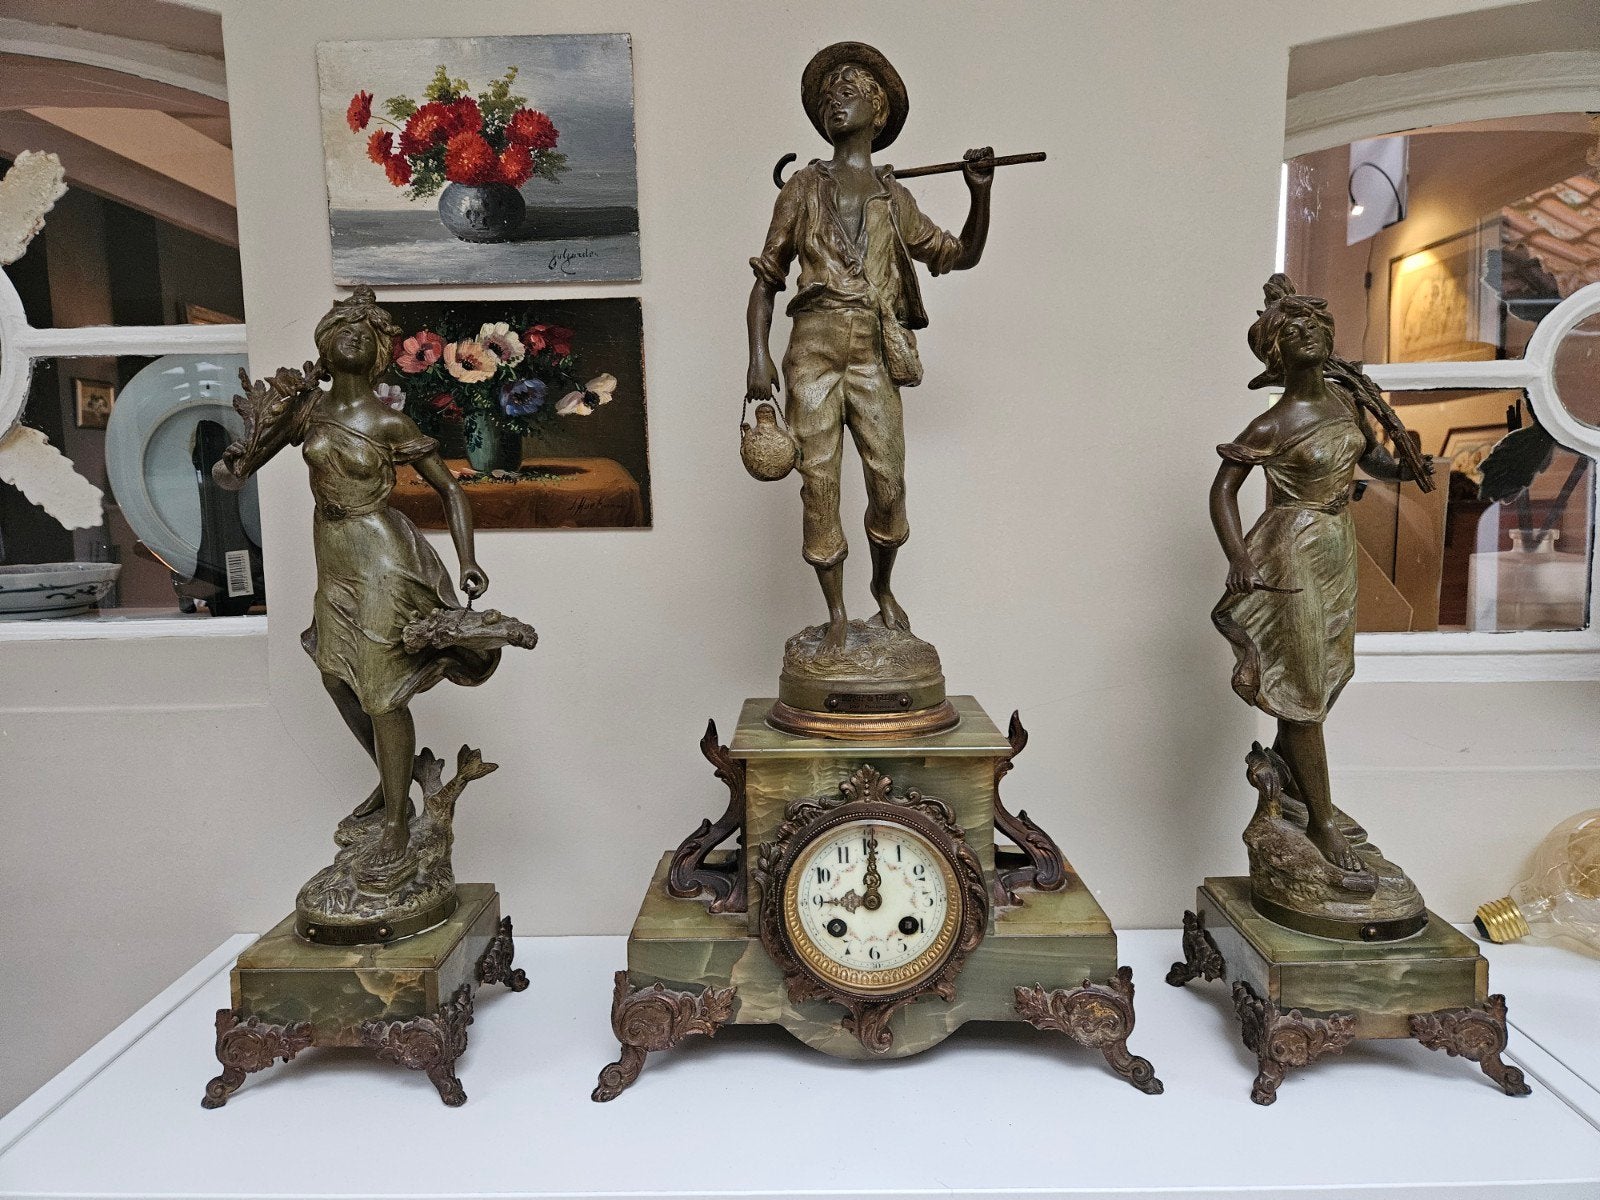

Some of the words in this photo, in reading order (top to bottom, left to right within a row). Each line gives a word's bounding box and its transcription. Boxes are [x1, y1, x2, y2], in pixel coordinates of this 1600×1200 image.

[838, 846, 849, 864] 11
[896, 845, 902, 862] 1
[816, 867, 831, 884] 10
[913, 864, 925, 882] 2
[813, 894, 824, 909] 9
[922, 890, 934, 907] 3
[842, 939, 851, 955] 7
[869, 946, 881, 960] 6
[897, 938, 907, 952] 5
